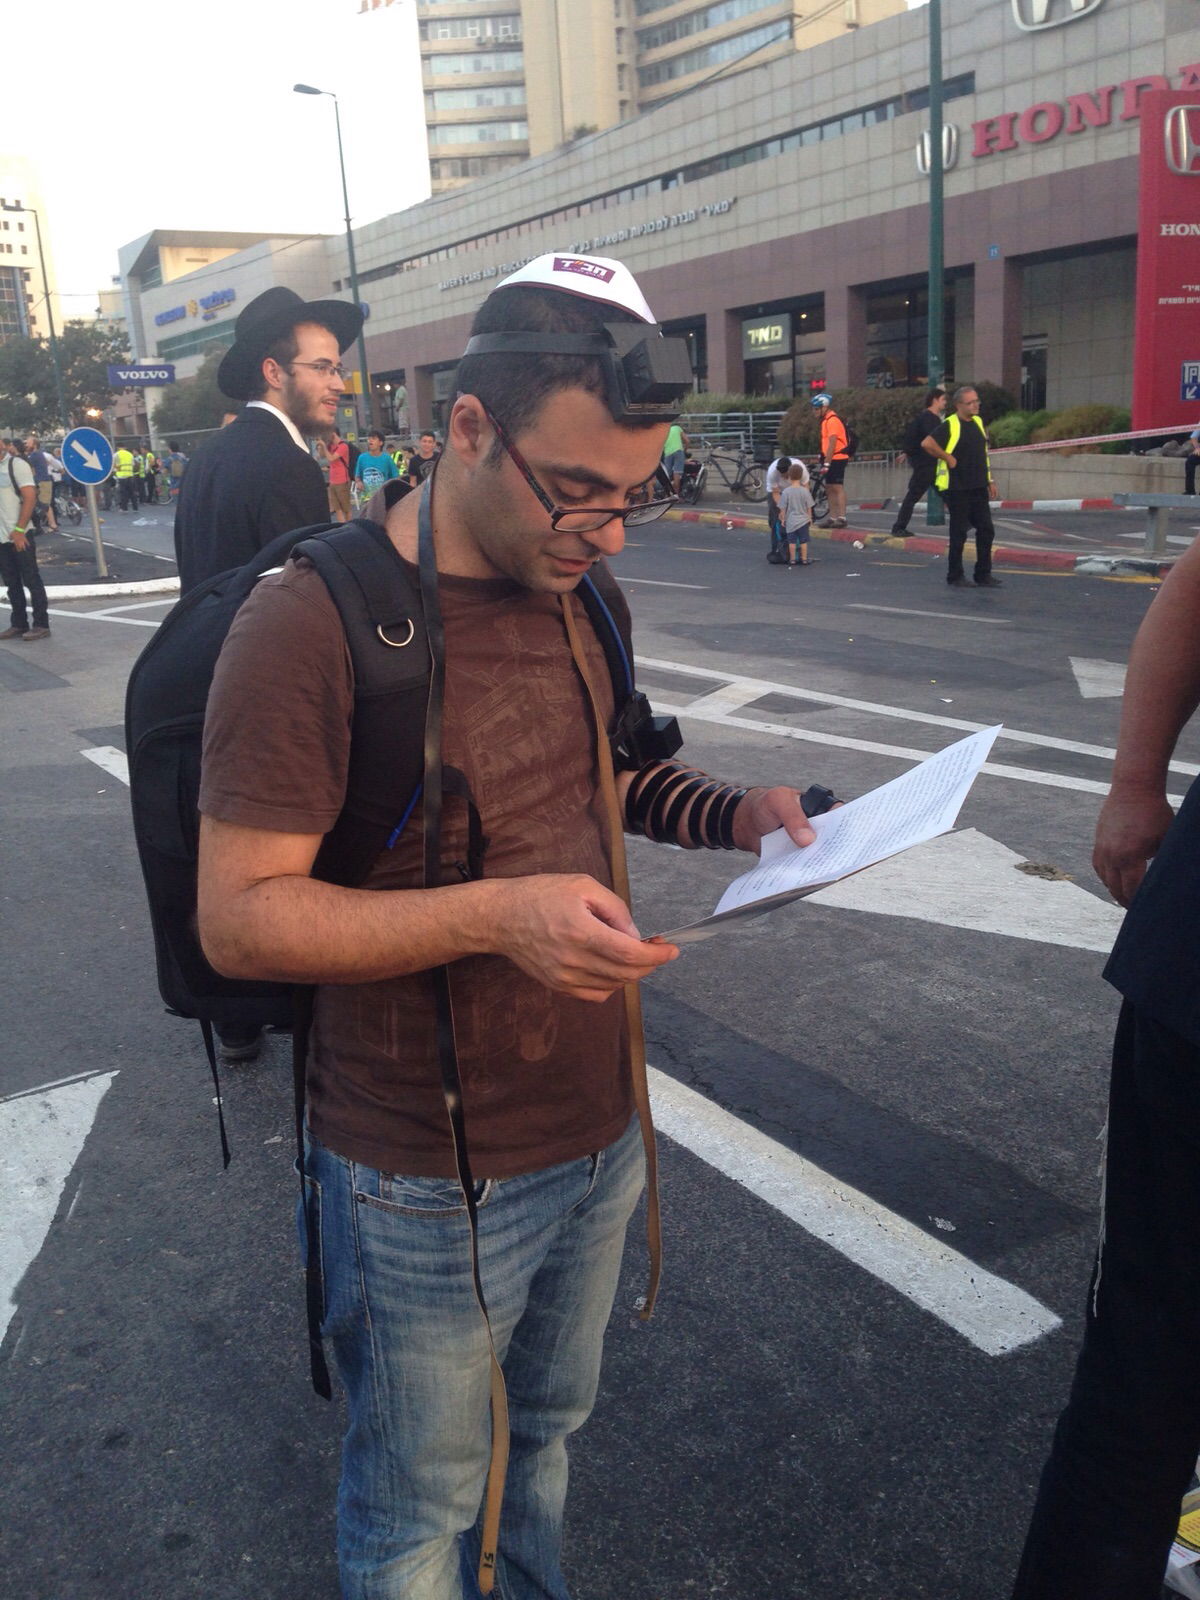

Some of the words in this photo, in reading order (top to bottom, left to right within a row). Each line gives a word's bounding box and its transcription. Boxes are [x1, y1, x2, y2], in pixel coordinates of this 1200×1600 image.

[670, 209, 697, 227] חברה
[747, 325, 783, 345] מאיר
[117, 370, 169, 380] VOLVO
